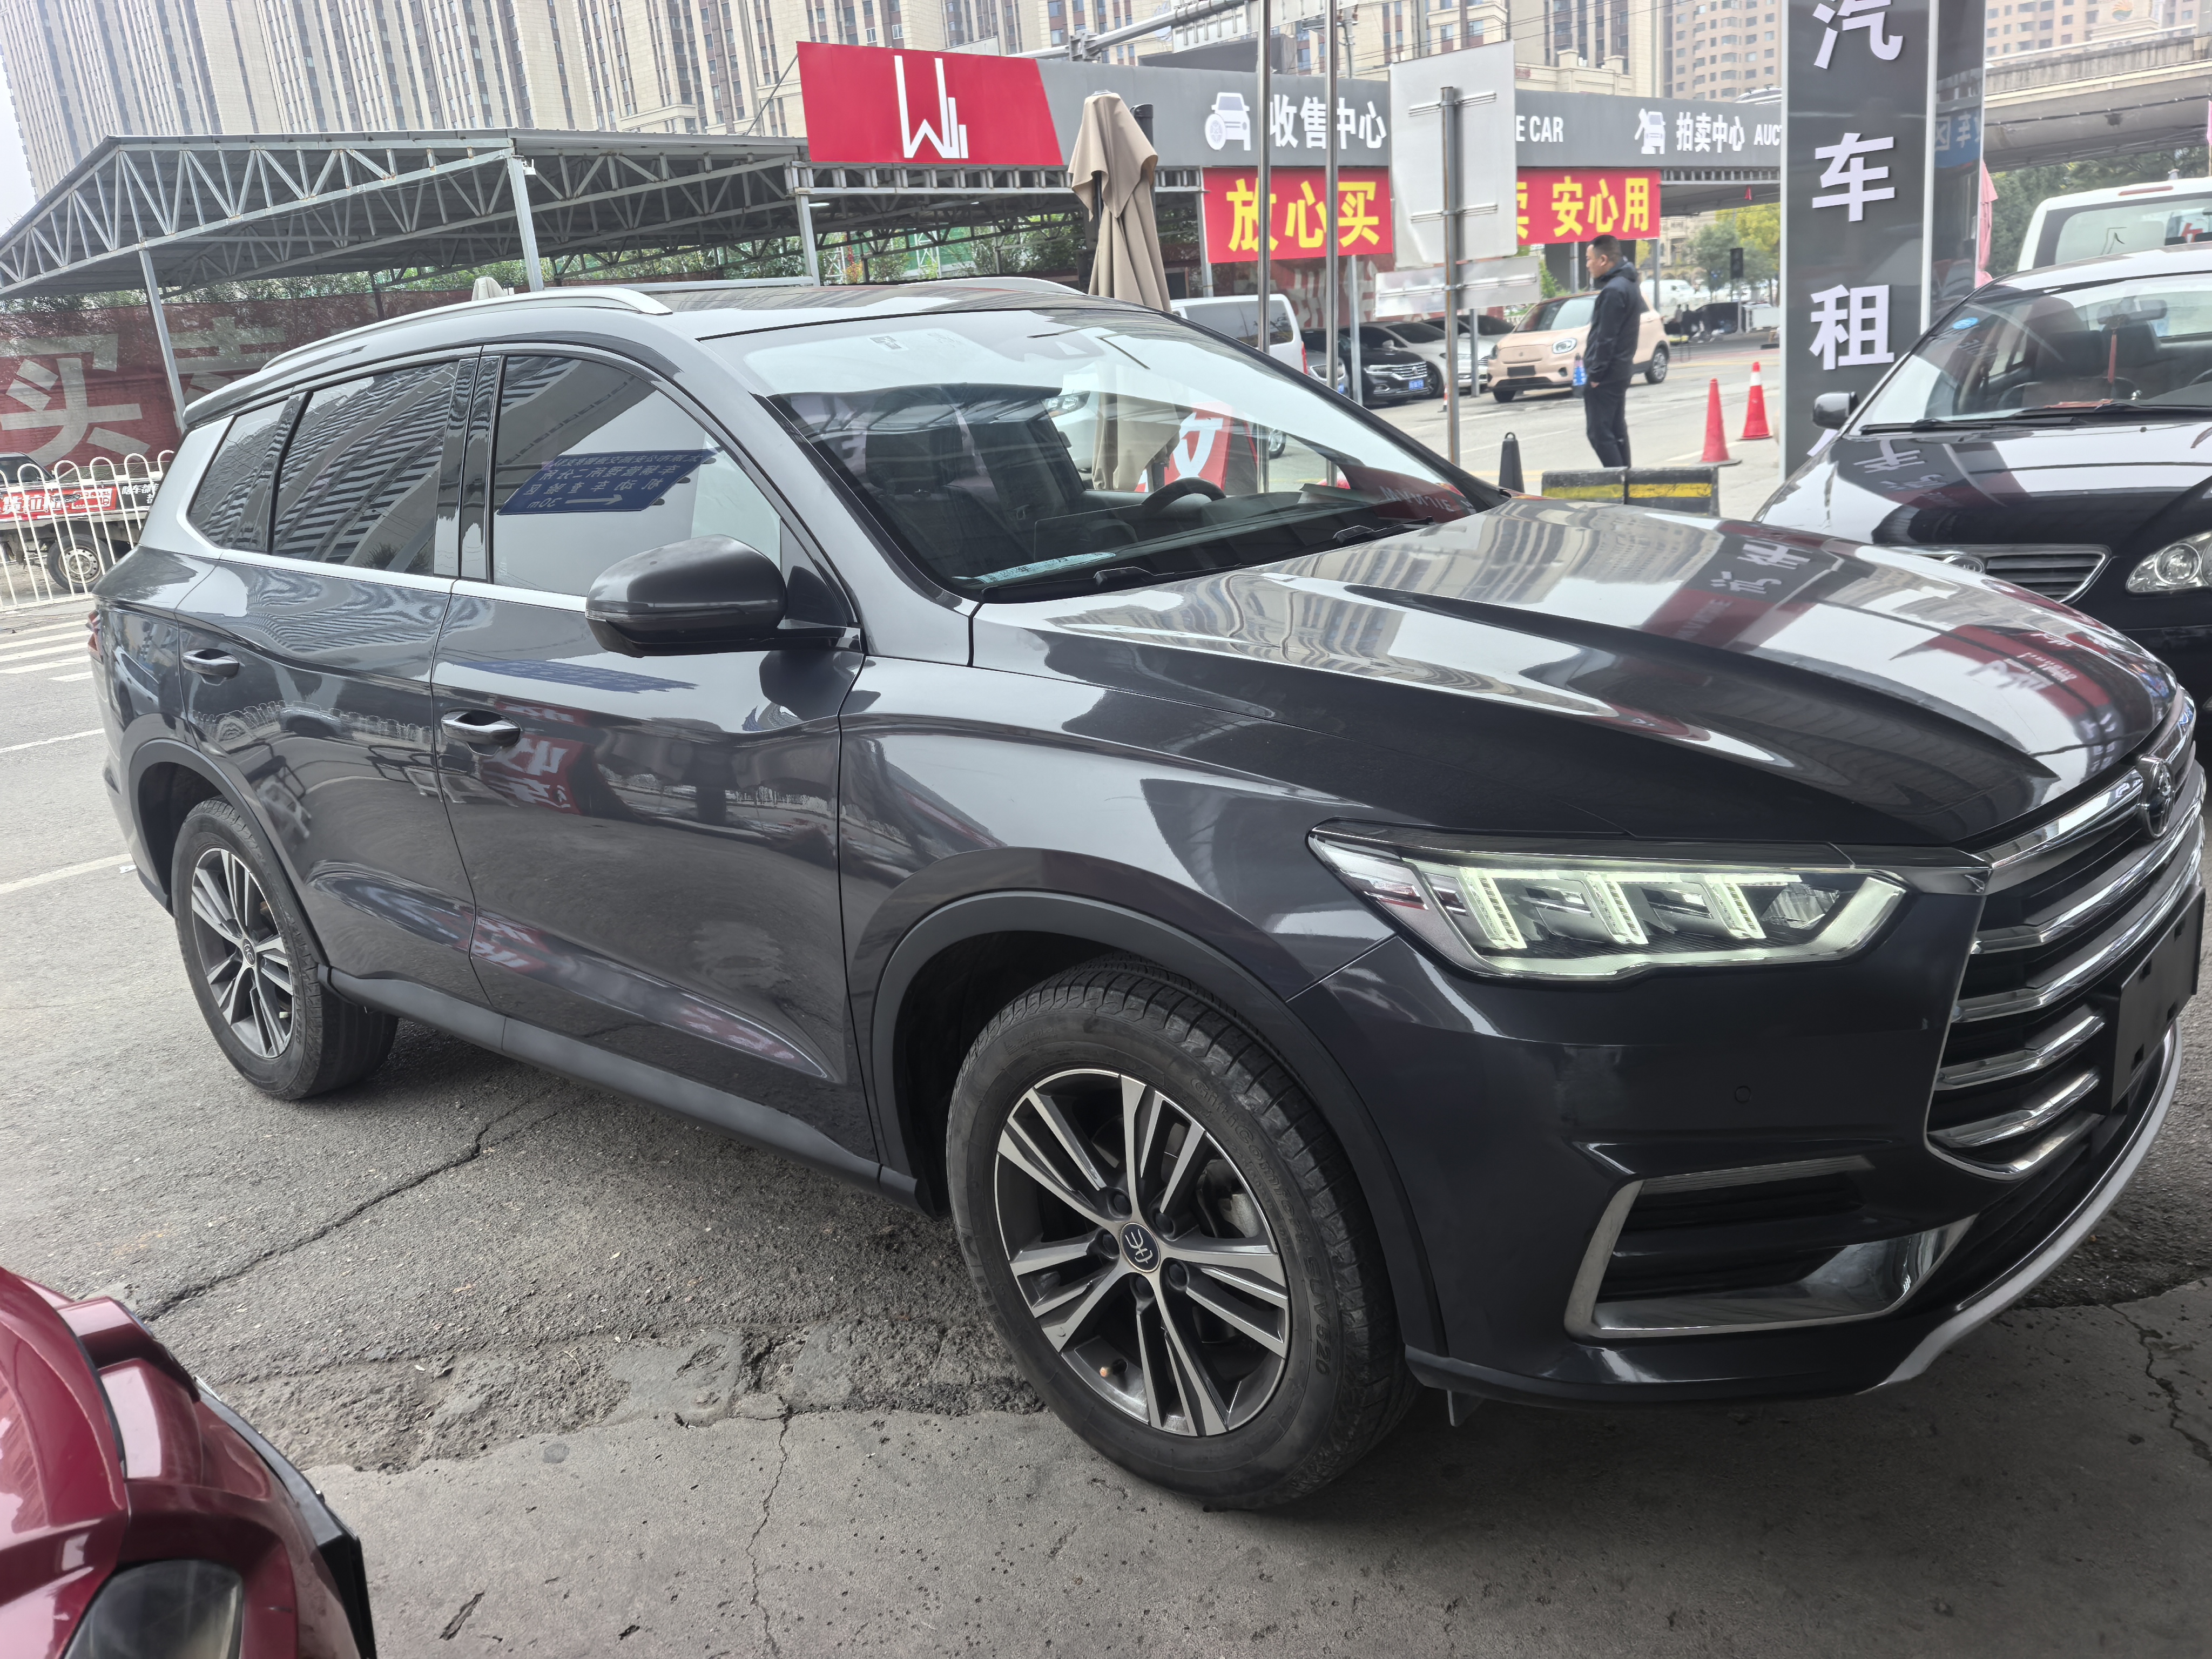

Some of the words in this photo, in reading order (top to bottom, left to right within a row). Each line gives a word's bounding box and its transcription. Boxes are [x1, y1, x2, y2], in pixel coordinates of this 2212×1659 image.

[1269, 94, 1387, 149] 收售中心
[1529, 116, 1564, 143] CAR
[1676, 111, 1745, 153] 拍卖中心
[1226, 177, 1380, 252] 放心买
[1551, 176, 1649, 237] 安心用
[1809, 0, 1904, 457] 汽车租
